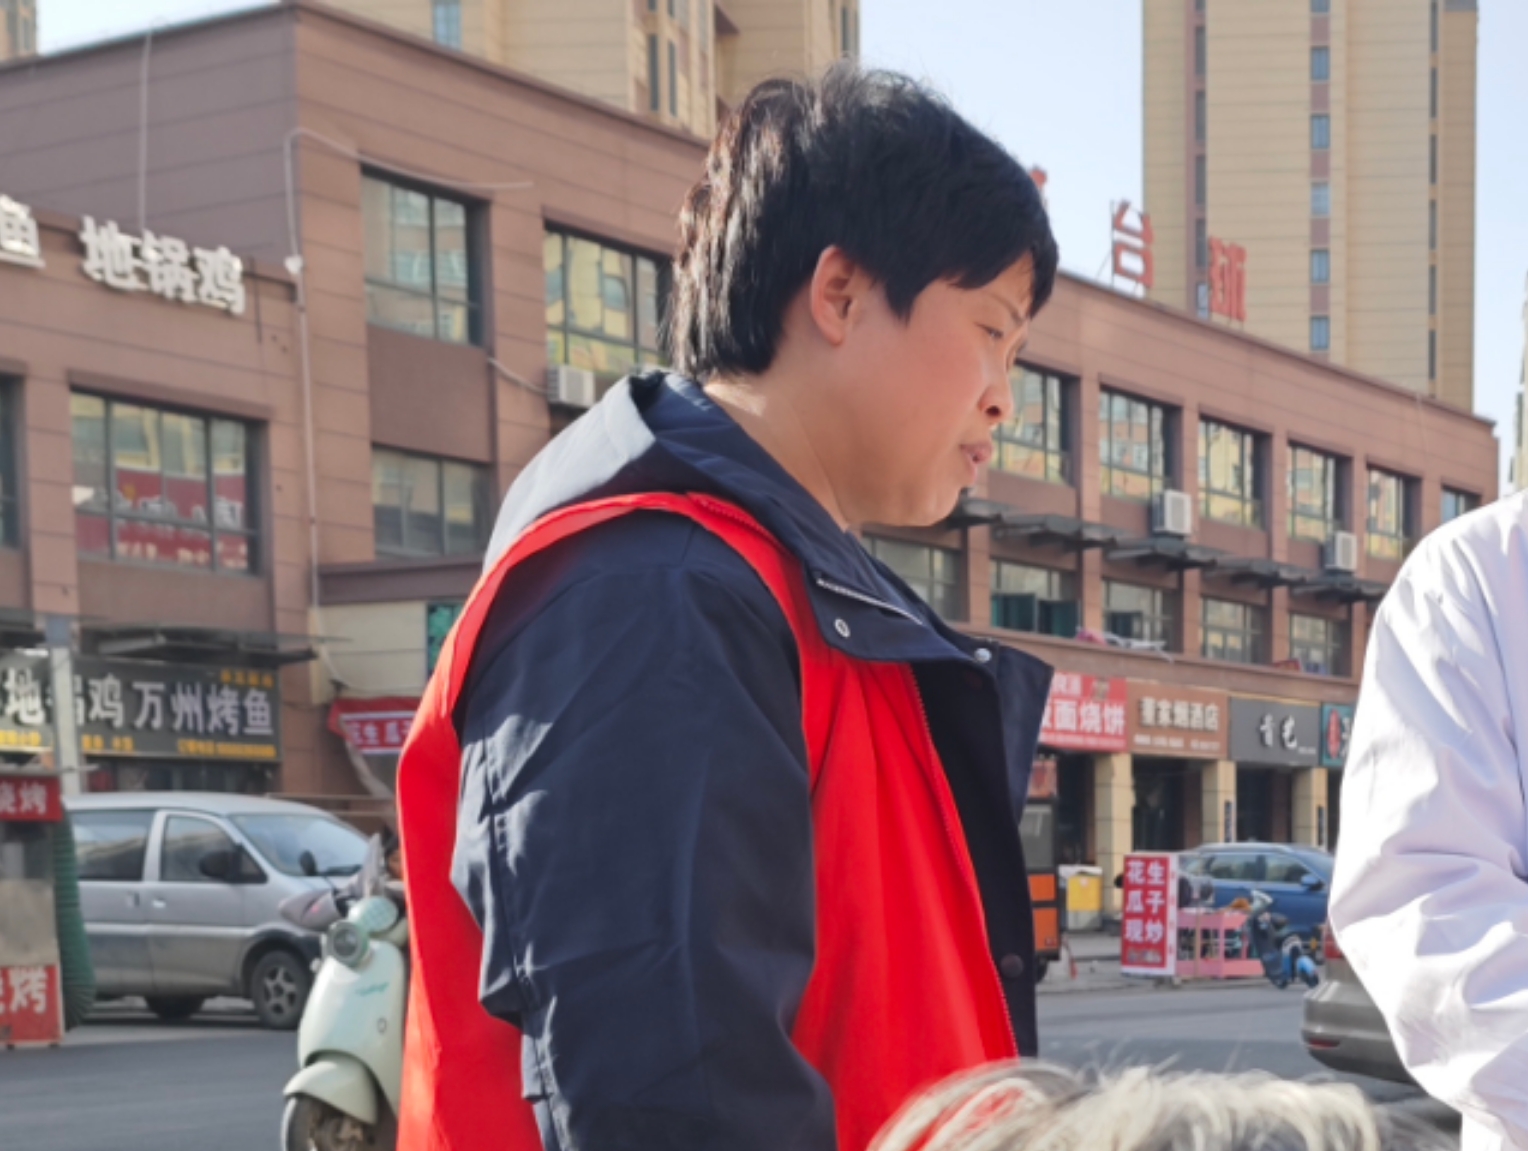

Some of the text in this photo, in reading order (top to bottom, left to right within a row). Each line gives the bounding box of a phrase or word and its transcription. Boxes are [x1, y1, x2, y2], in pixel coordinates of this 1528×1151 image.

[80, 215, 247, 316] 地锅鸡
[1125, 858, 1165, 886] 花生
[1125, 888, 1165, 915] 瓜子
[1124, 918, 1164, 945] 现炒
[0, 965, 47, 1015] 烤
